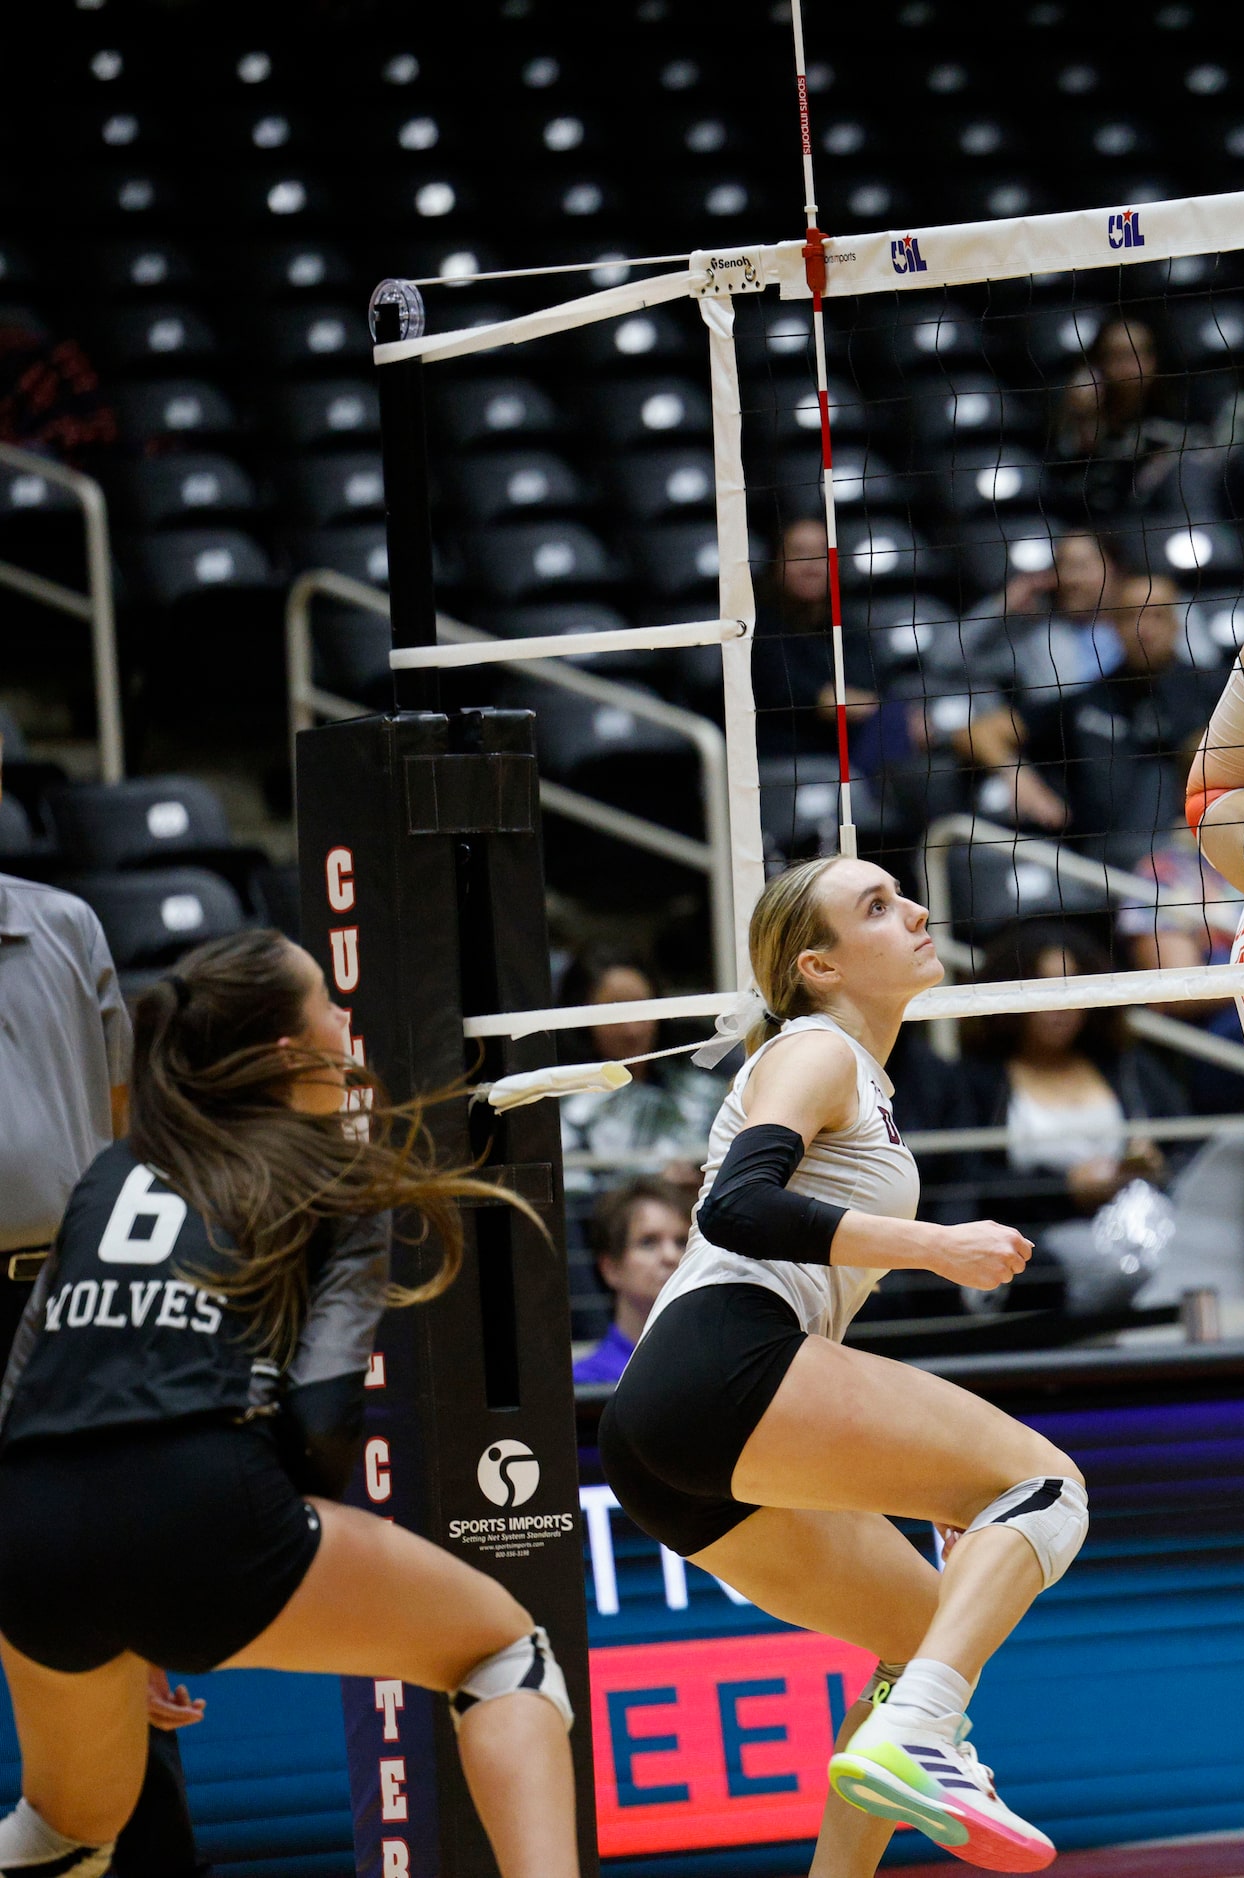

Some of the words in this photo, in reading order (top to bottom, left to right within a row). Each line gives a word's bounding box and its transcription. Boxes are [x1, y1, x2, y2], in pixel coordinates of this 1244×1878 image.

[1108, 209, 1145, 248] UIL
[718, 256, 750, 269] Senoh
[891, 235, 927, 273] UIL
[98, 1163, 187, 1265] 6
[448, 1517, 506, 1538] SPORTS
[508, 1513, 574, 1531] IMPORTS
[462, 1534, 486, 1544] Setting
[487, 1533, 500, 1541] Net
[501, 1532, 525, 1542] System
[526, 1530, 562, 1539] Standards
